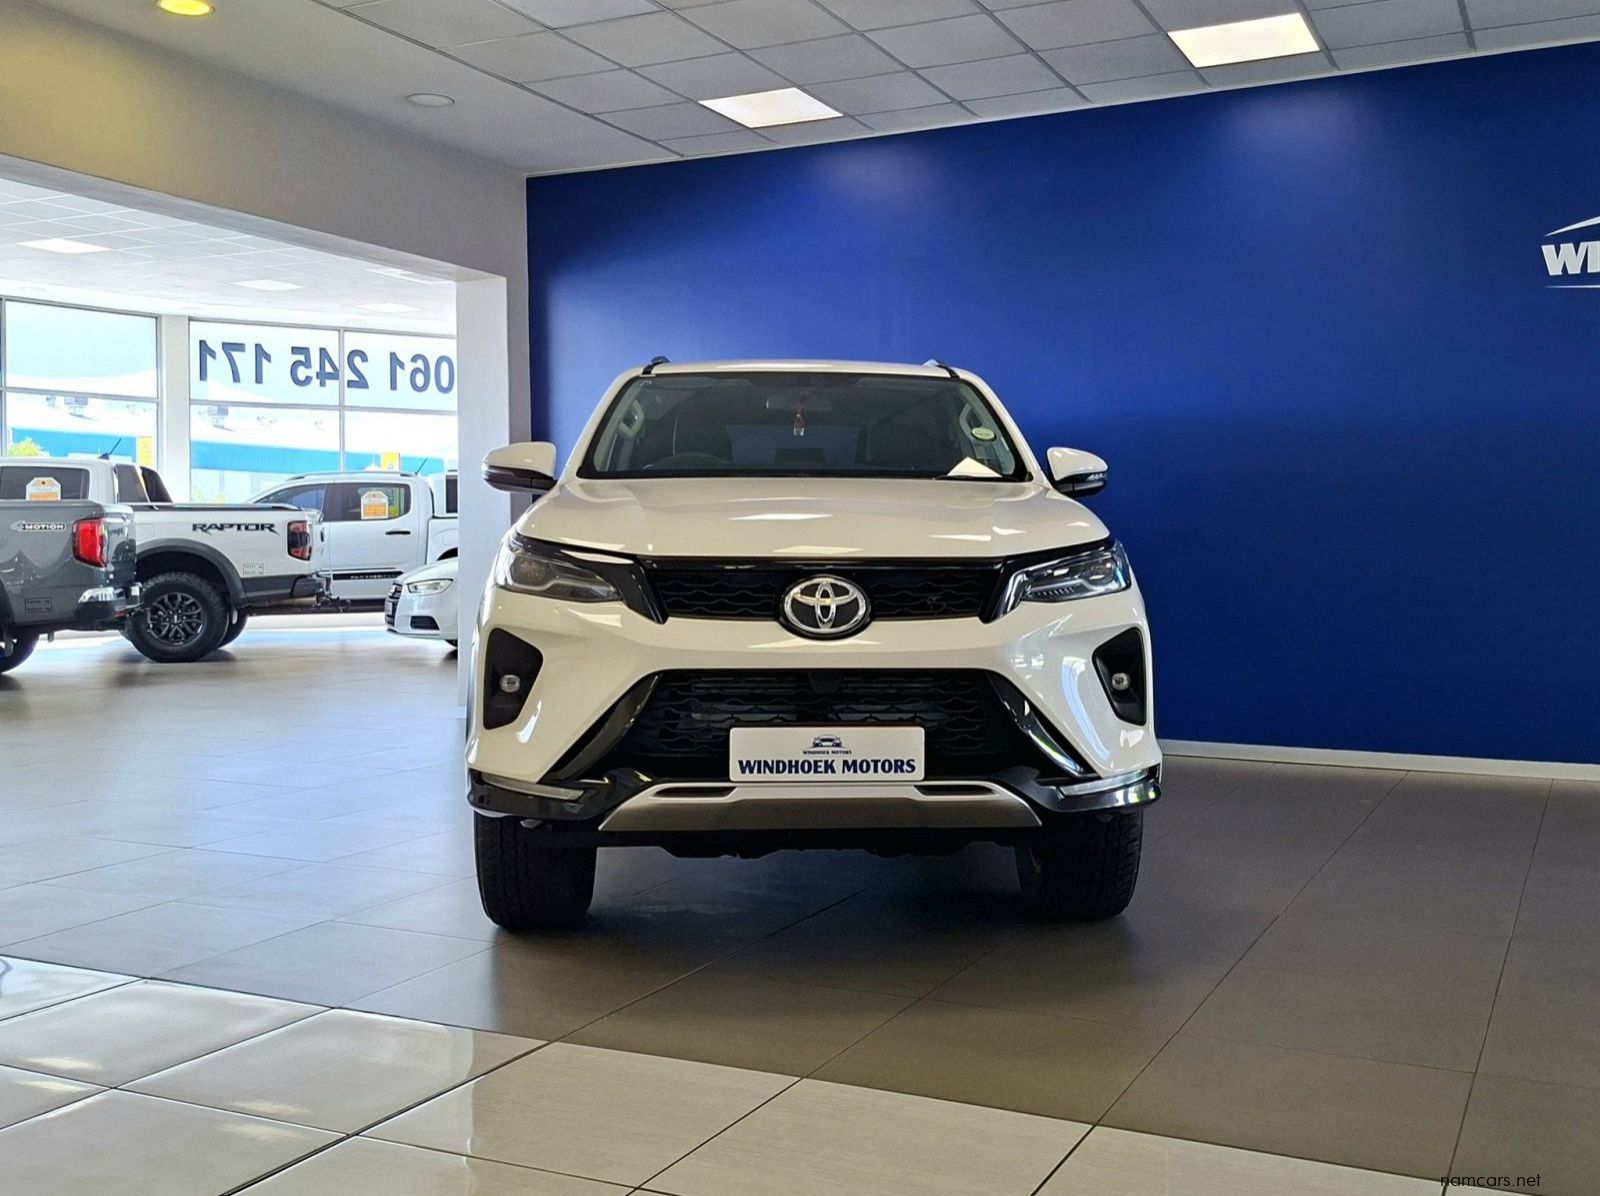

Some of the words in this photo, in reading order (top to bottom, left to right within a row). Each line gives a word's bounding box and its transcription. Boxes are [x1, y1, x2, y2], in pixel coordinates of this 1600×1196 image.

[192, 523, 280, 536] RAPTOR
[738, 759, 836, 774] WINDHOEK
[841, 759, 916, 774] MOTORS
